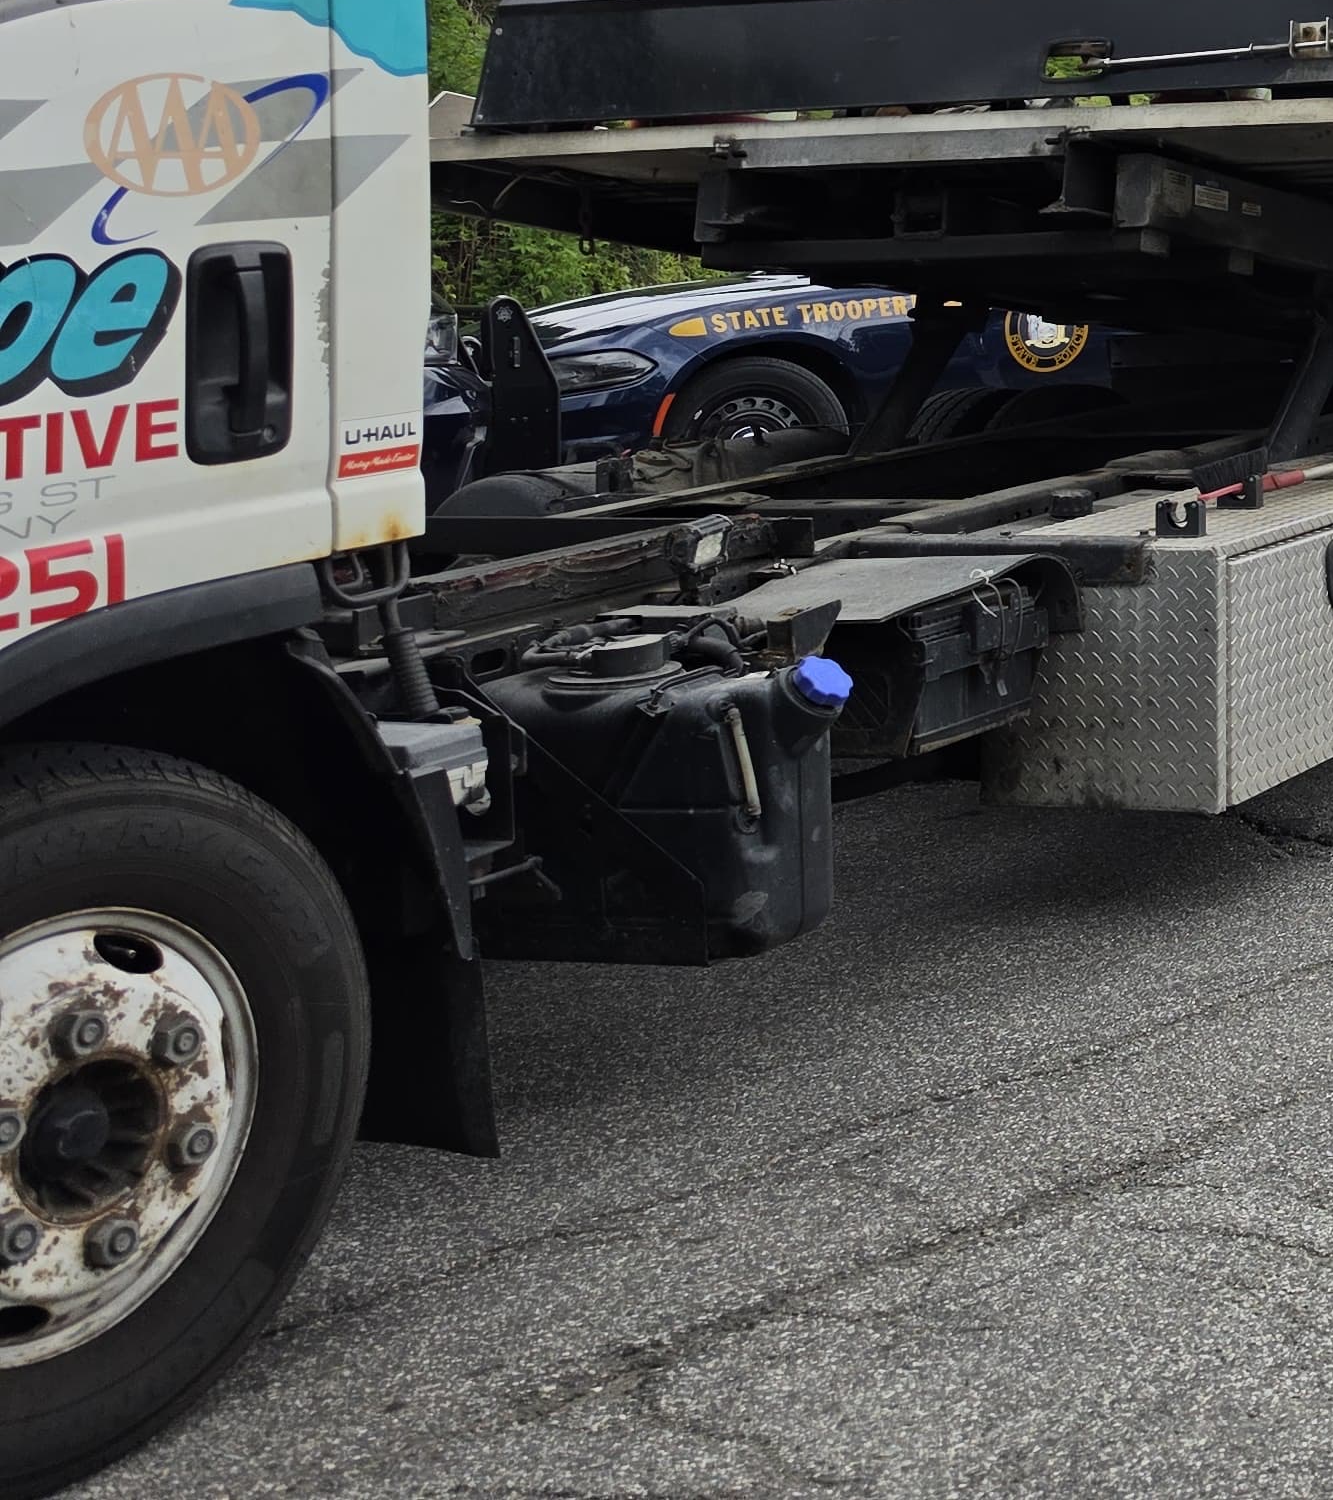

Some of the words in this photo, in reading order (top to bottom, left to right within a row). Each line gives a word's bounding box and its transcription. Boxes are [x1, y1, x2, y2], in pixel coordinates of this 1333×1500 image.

[100, 74, 246, 197] AAA
[711, 306, 789, 334] STATE
[0, 398, 180, 481] TIVE
[345, 422, 417, 446] U-HAUL
[40, 475, 117, 508] ST
